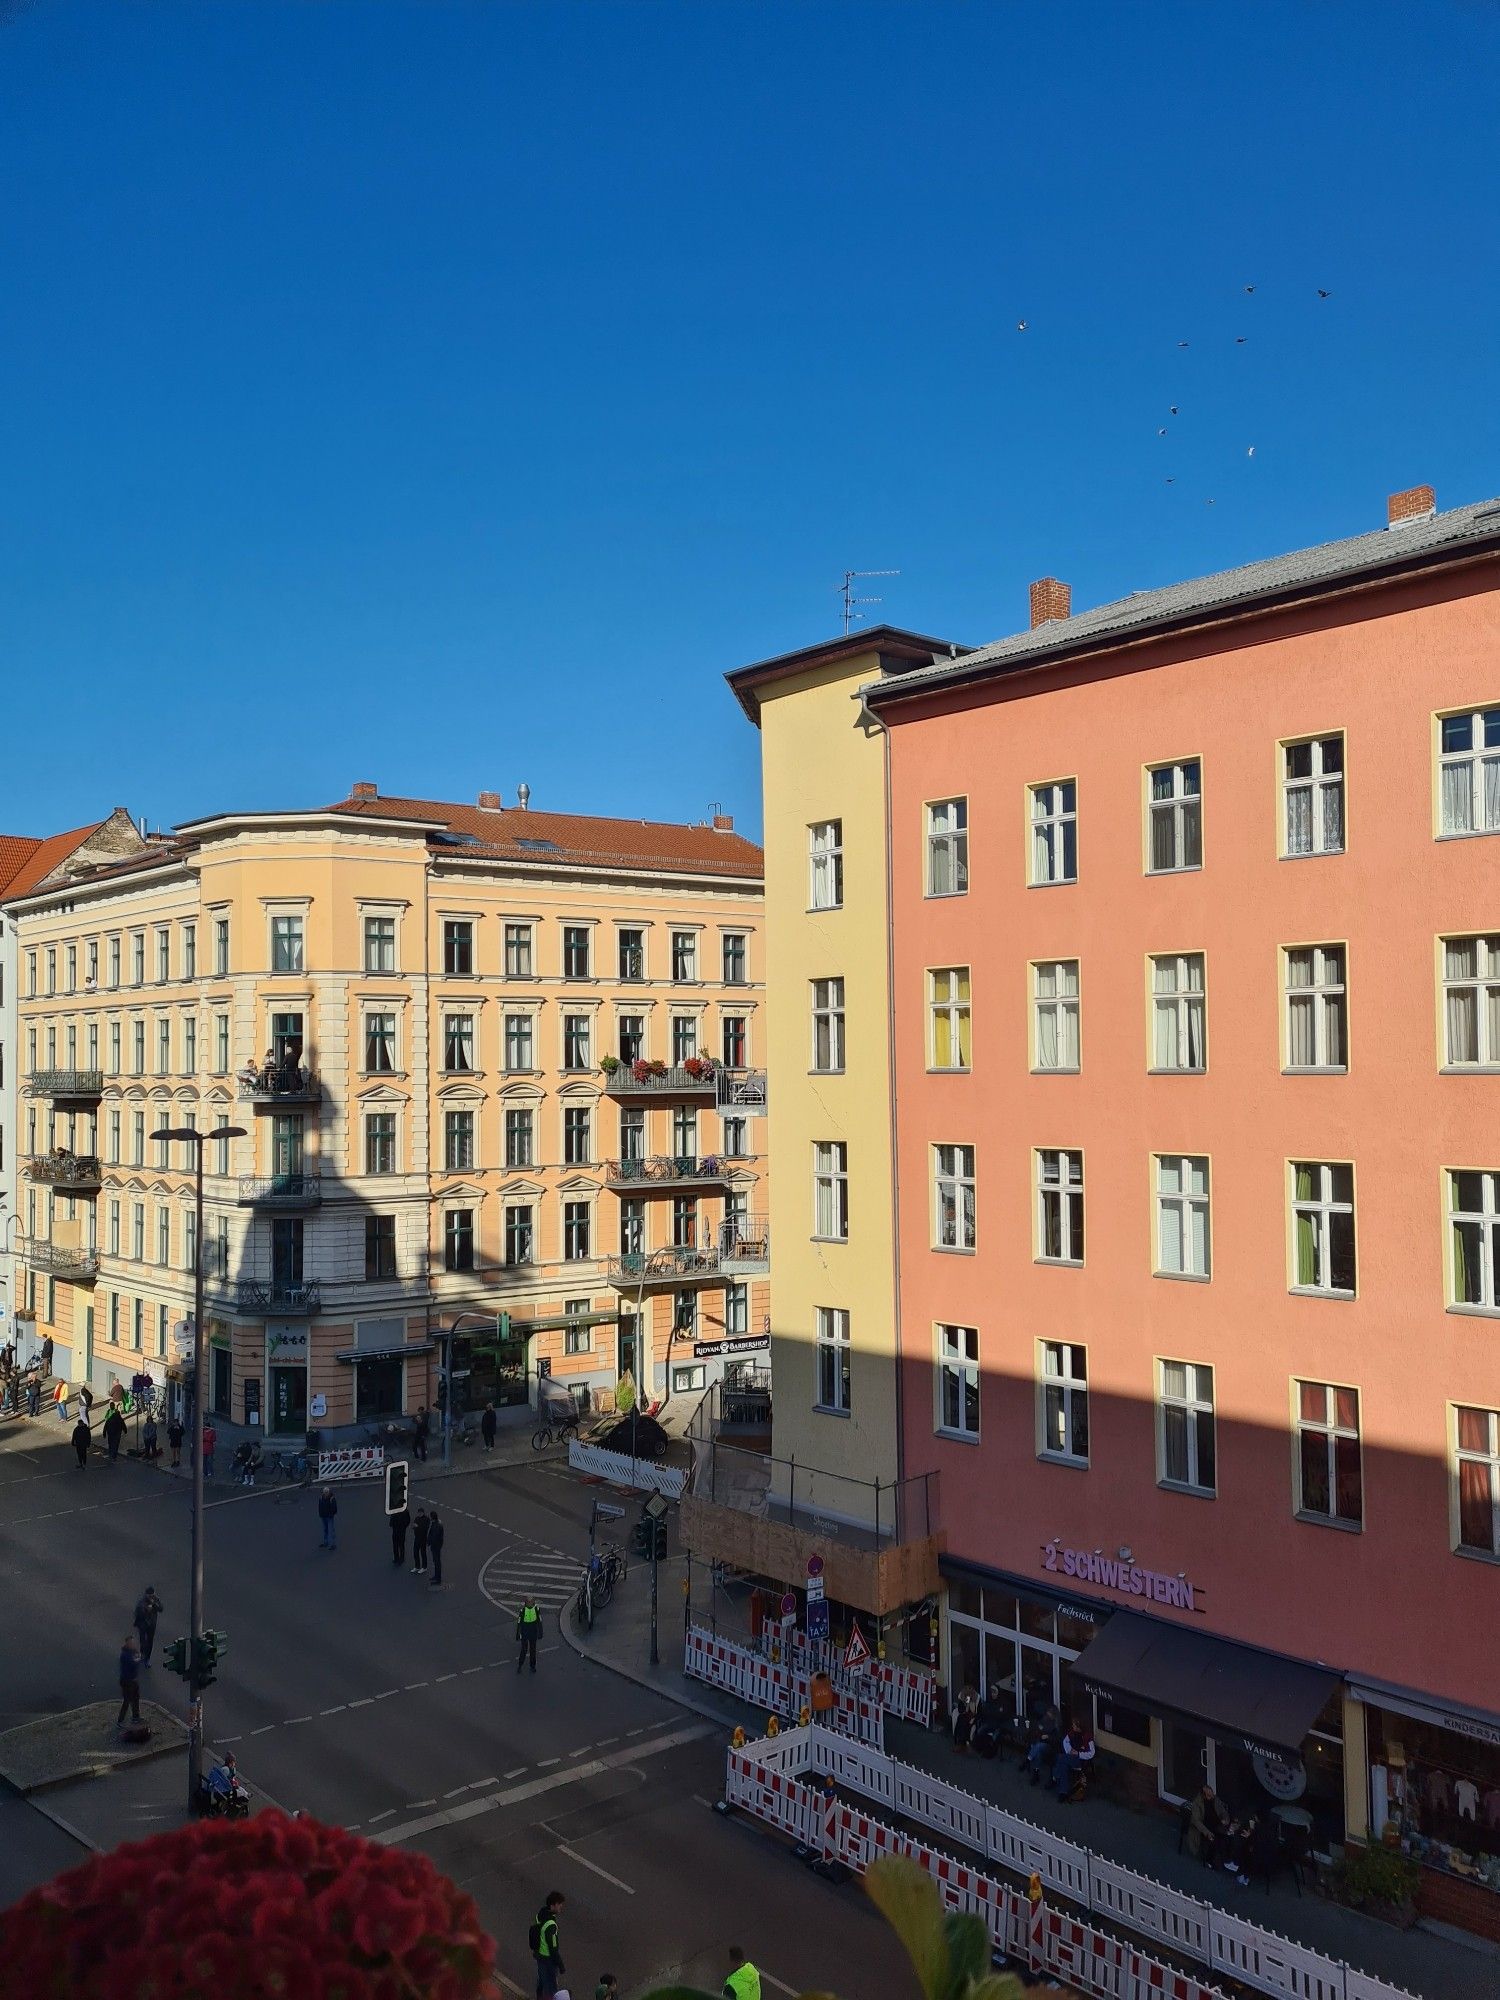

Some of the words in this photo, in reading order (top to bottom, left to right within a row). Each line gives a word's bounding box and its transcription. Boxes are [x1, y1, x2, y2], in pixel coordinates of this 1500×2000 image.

[729, 1340, 768, 1350] BARBERSHOP
[1044, 1543, 1058, 1572] 2
[1063, 1548, 1195, 1611] SCHWESTERN
[1444, 1717, 1500, 1742] KINDERSA
